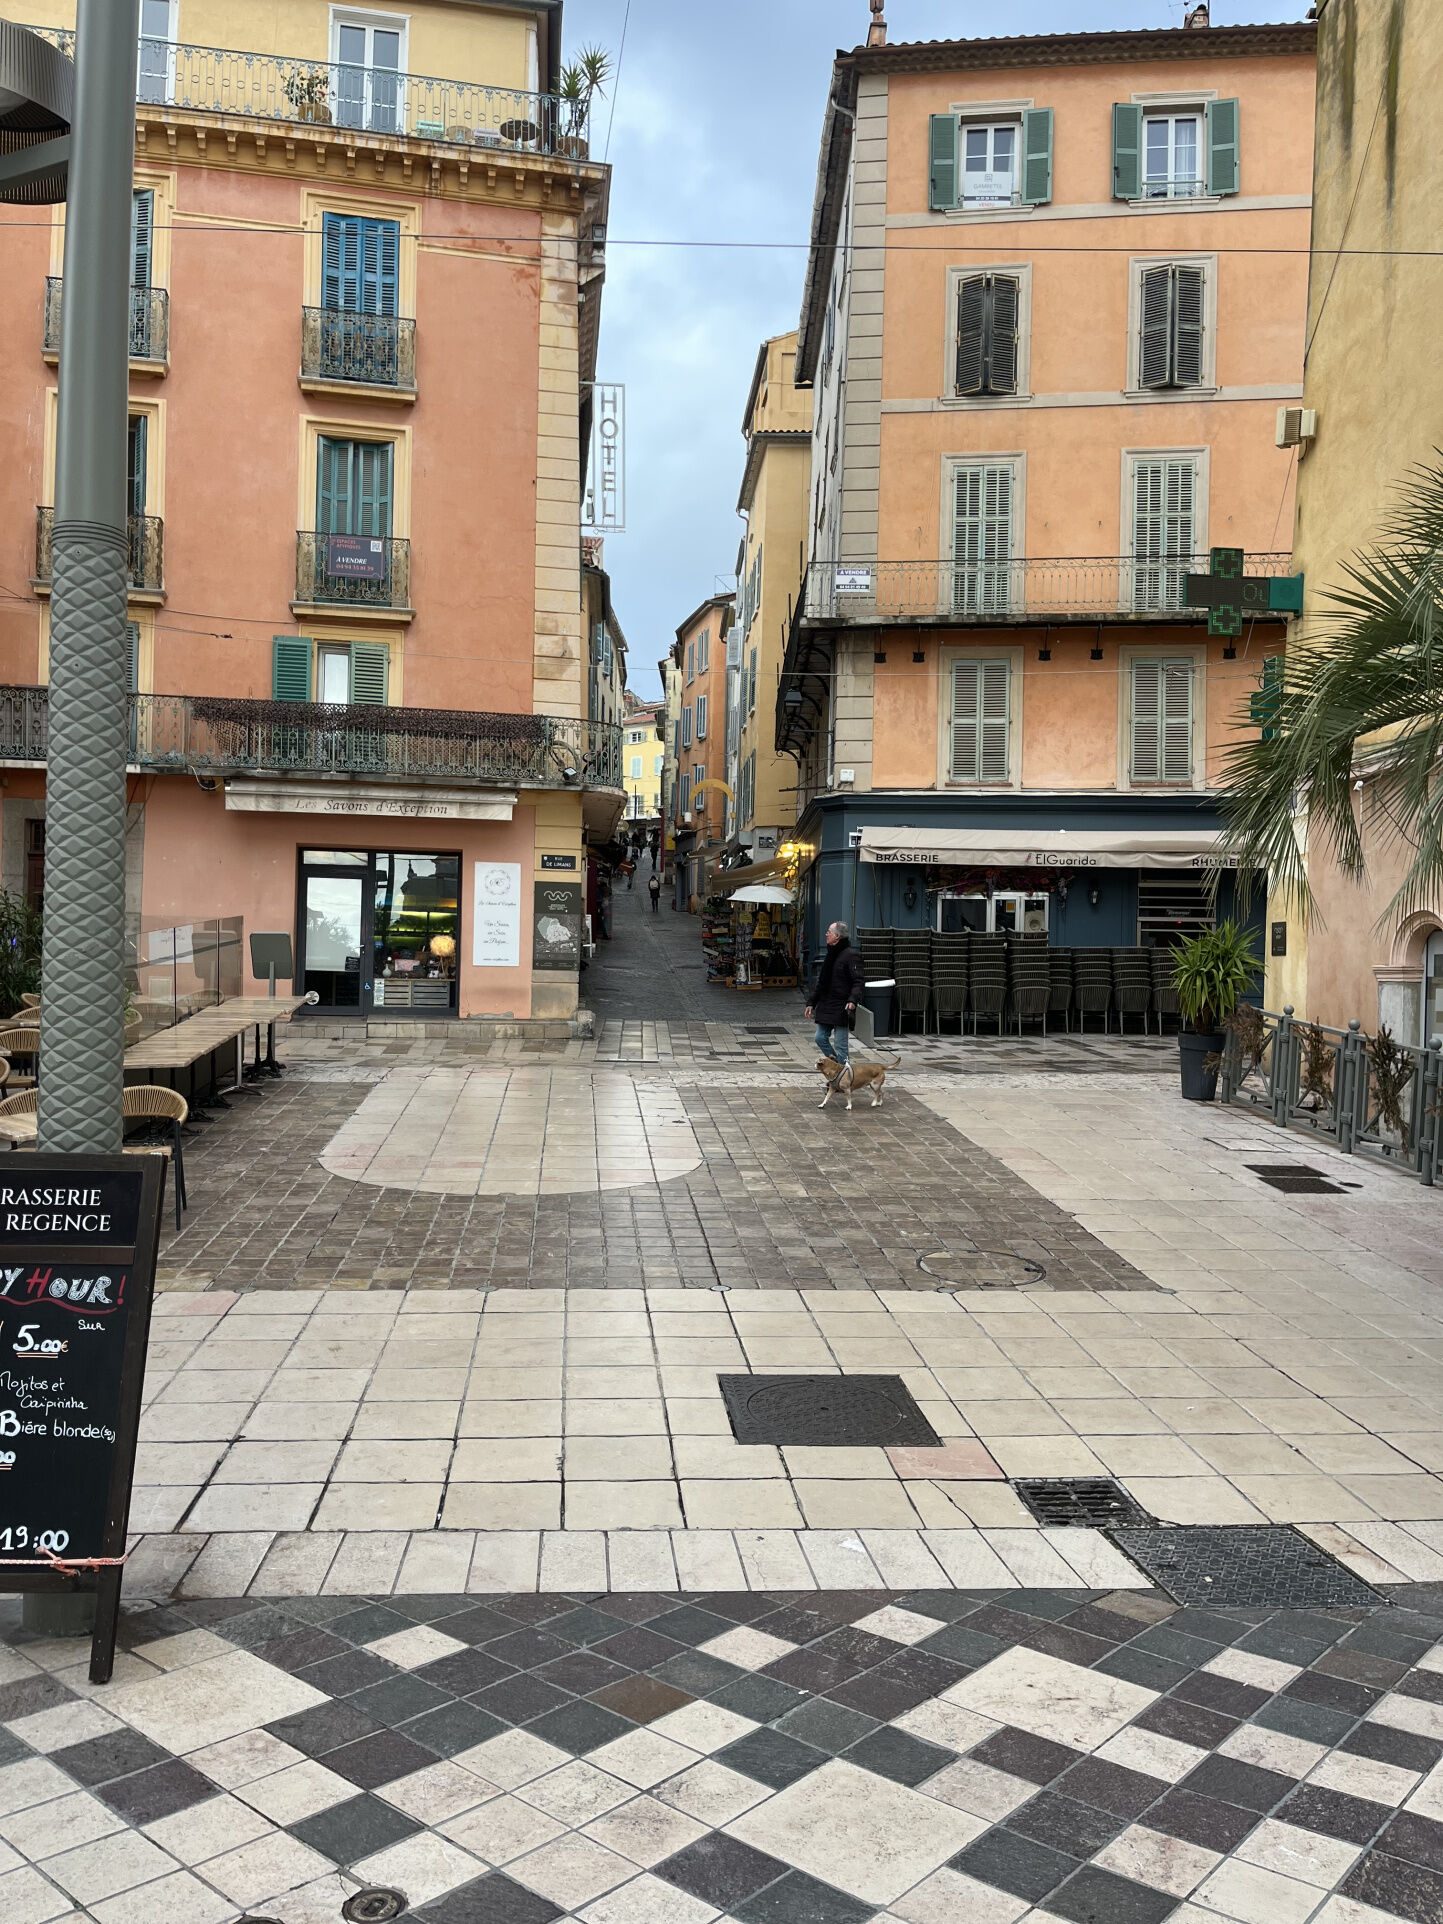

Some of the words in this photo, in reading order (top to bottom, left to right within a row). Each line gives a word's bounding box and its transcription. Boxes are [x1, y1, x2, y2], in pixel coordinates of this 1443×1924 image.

[600, 391, 619, 518] HOTEL
[342, 557, 368, 565] VENDRE
[324, 800, 369, 812] Savons
[376, 800, 449, 817] d'Exception
[875, 853, 939, 863] BRASSERIE
[5, 1213, 111, 1232] REGENCE
[0, 1267, 24, 1296] Y
[51, 1377, 66, 1391] et
[0, 1526, 70, 1552] 19:00
